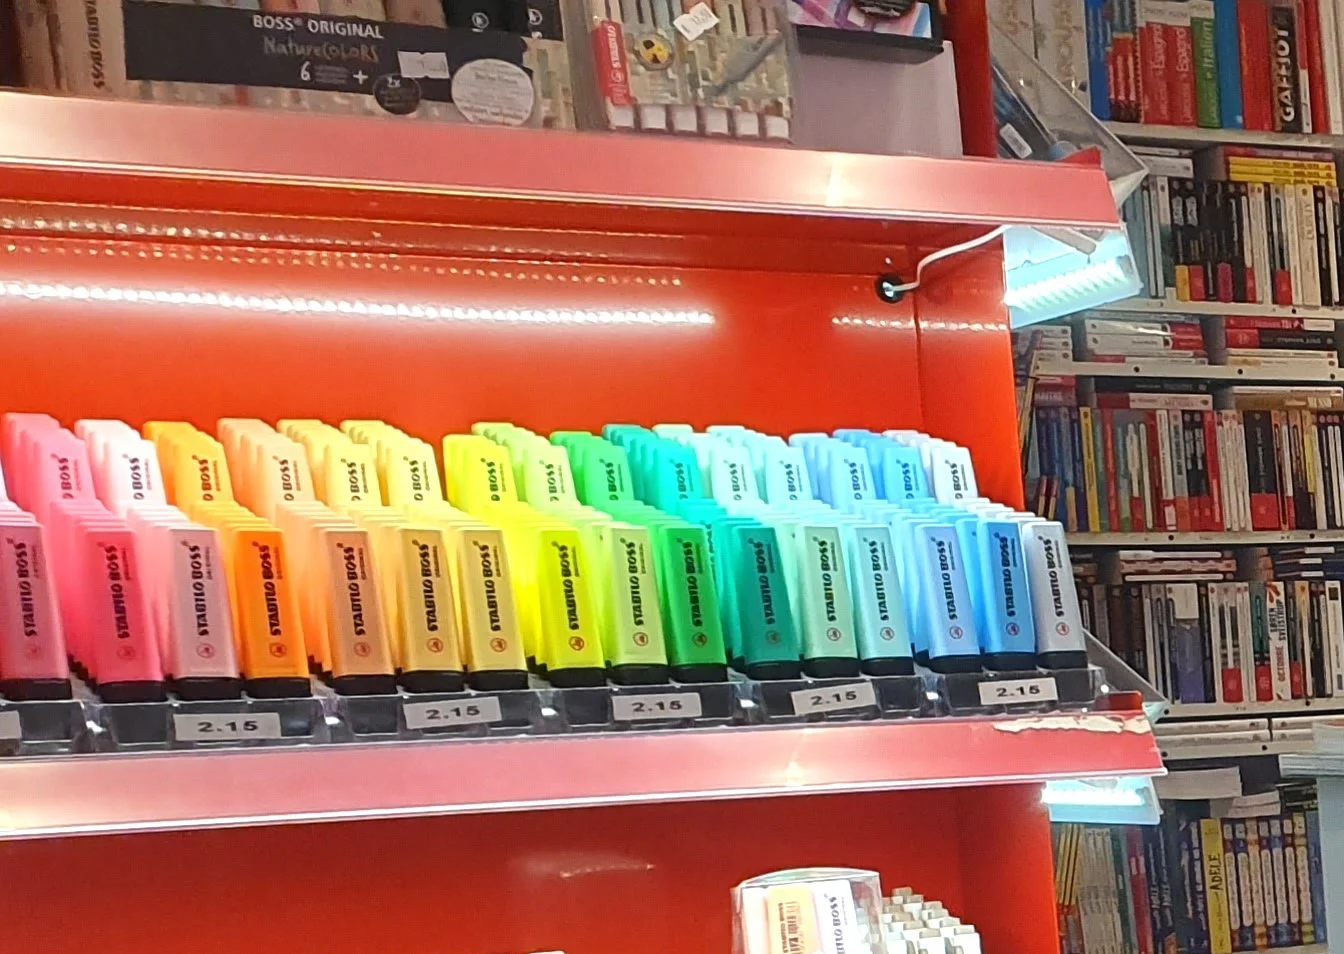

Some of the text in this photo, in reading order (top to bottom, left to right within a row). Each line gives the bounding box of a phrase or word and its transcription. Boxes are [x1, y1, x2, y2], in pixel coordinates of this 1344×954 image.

[308, 20, 384, 40] ORIGINAL
[299, 62, 311, 82] 6
[14, 543, 38, 637] STABILO BOSS
[189, 545, 209, 636] STABILO BOSS
[259, 544, 281, 636] STABILO BOSS
[343, 546, 366, 636] STABILO BOSS
[418, 543, 438, 632] STABILO BOSS
[480, 544, 501, 632] STABILO BOSS
[559, 545, 580, 630] STABILO BOSS
[626, 541, 645, 626] STABILO BOSS
[683, 541, 703, 627] STABILO BOSS
[818, 540, 837, 622] STABILO BOSS
[869, 540, 889, 621] STABILO BOSS
[936, 540, 958, 620] STABILO BOSS
[999, 536, 1016, 617] STABILO BOSS
[1045, 538, 1064, 617] STABILO BOSS
[197, 720, 259, 733] 2.15
[425, 705, 481, 720] 2.15
[631, 700, 683, 713] 2.15
[809, 690, 858, 706] 2.15
[995, 684, 1041, 698] 2.15
